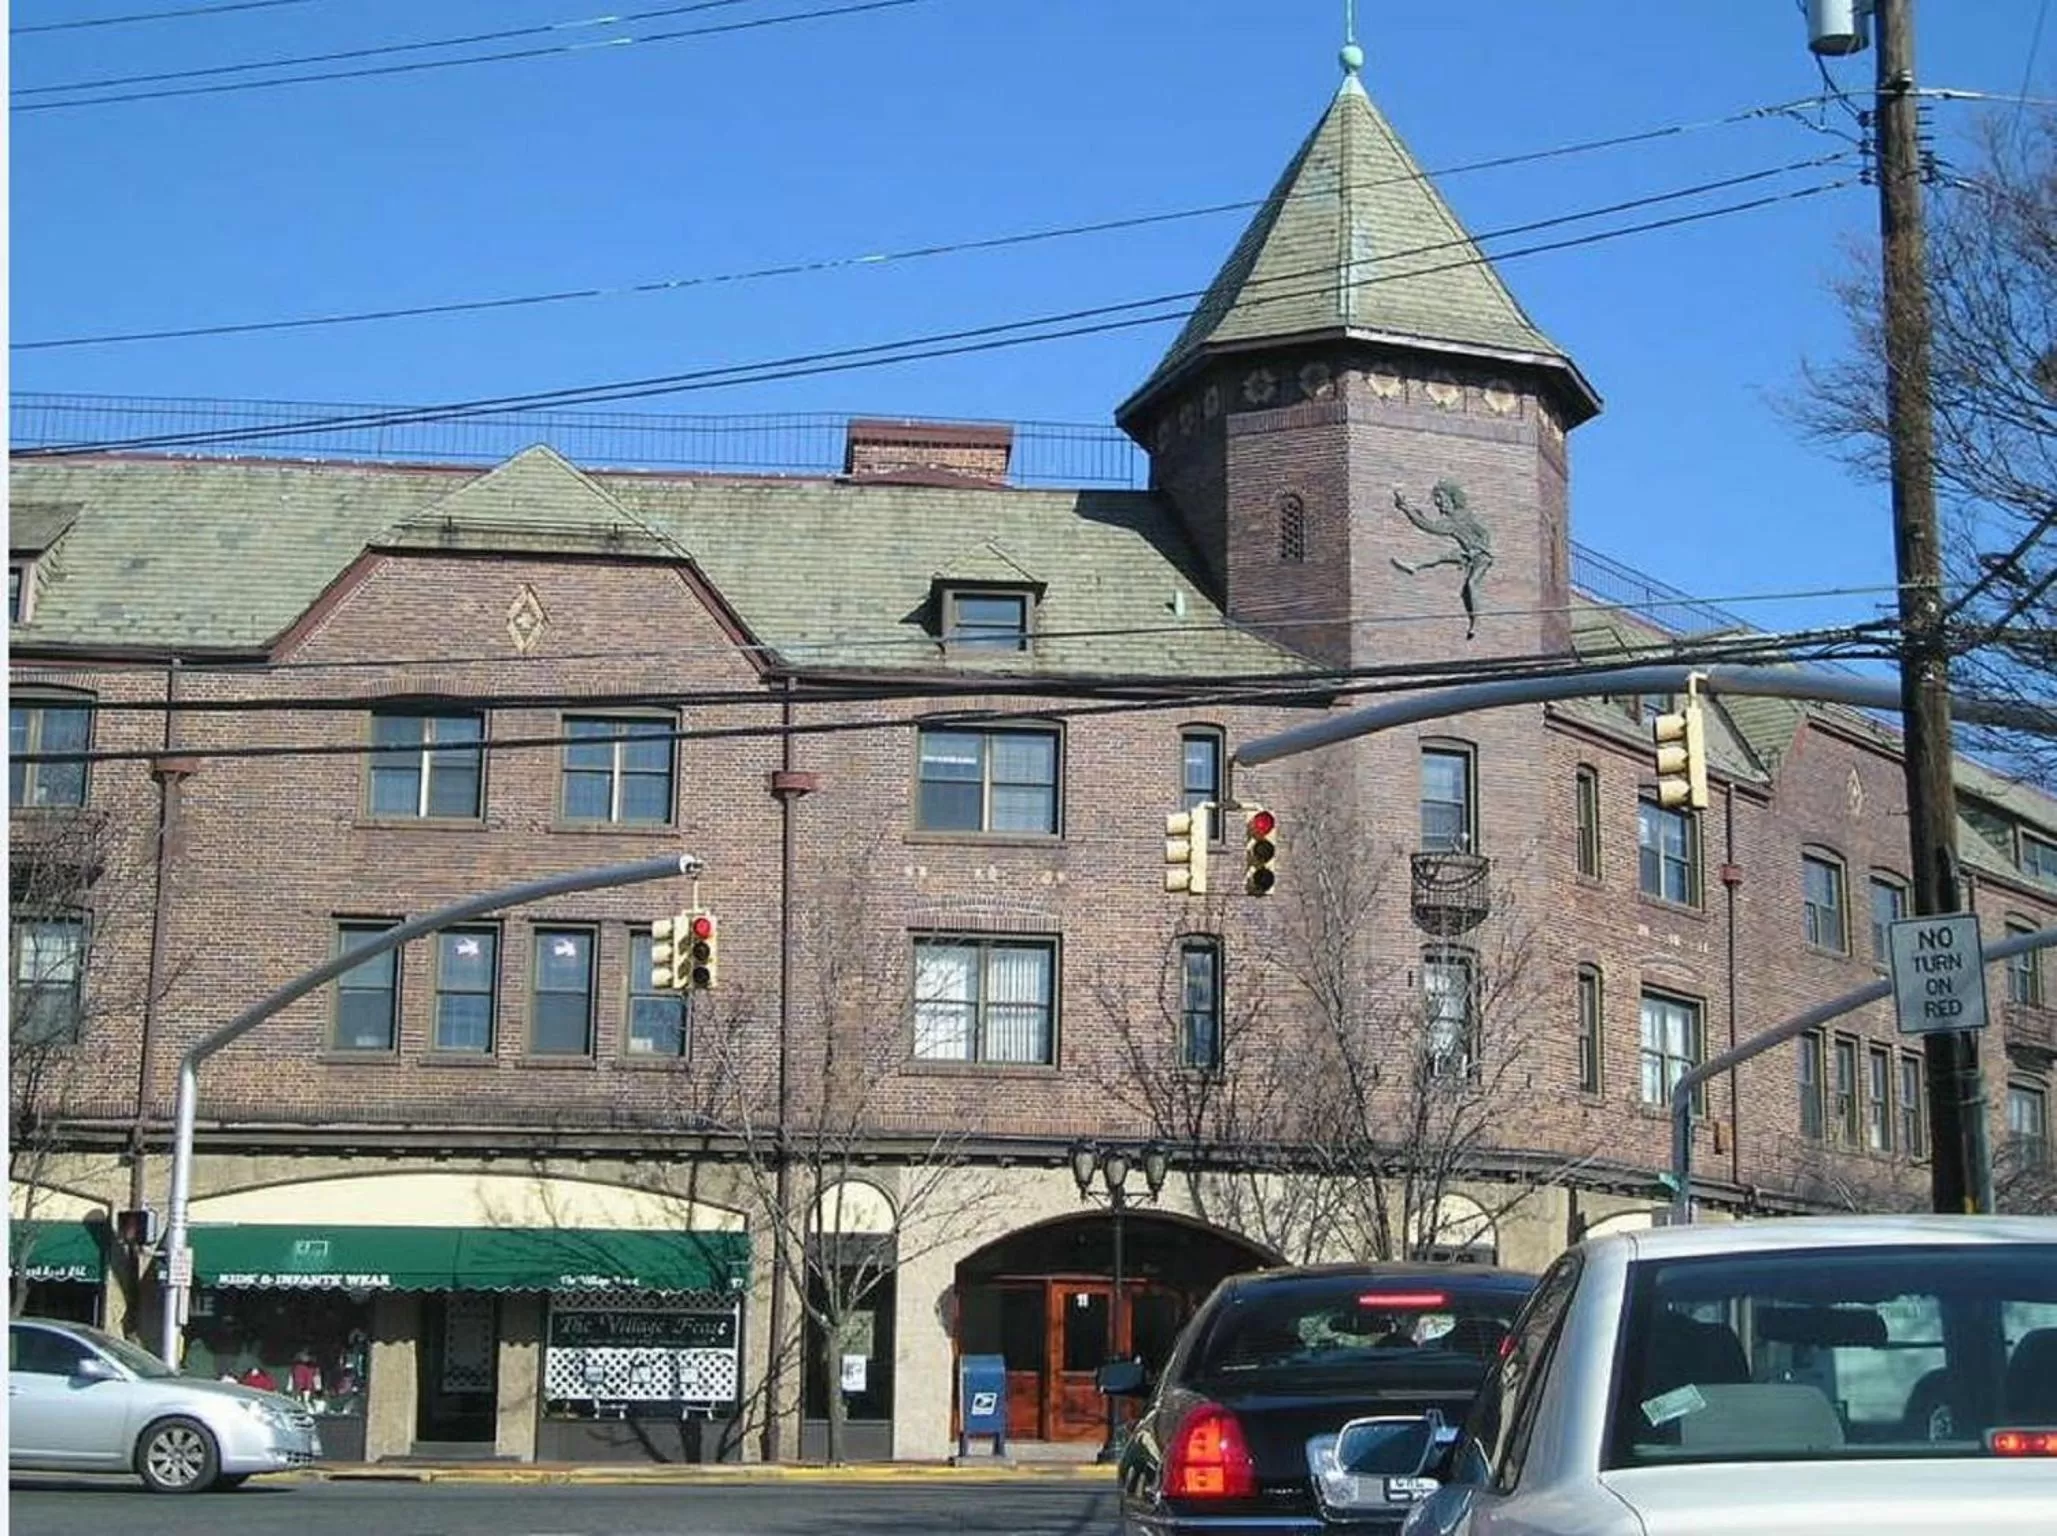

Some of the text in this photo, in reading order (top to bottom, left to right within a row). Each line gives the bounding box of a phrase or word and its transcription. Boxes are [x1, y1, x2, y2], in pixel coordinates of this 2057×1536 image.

[1918, 926, 1953, 950] NO
[1913, 953, 1962, 973] TURN
[1925, 976, 1952, 996] ON
[1924, 999, 1962, 1018] RED
[345, 1274, 390, 1286] WEAR
[601, 1314, 663, 1339] Village
